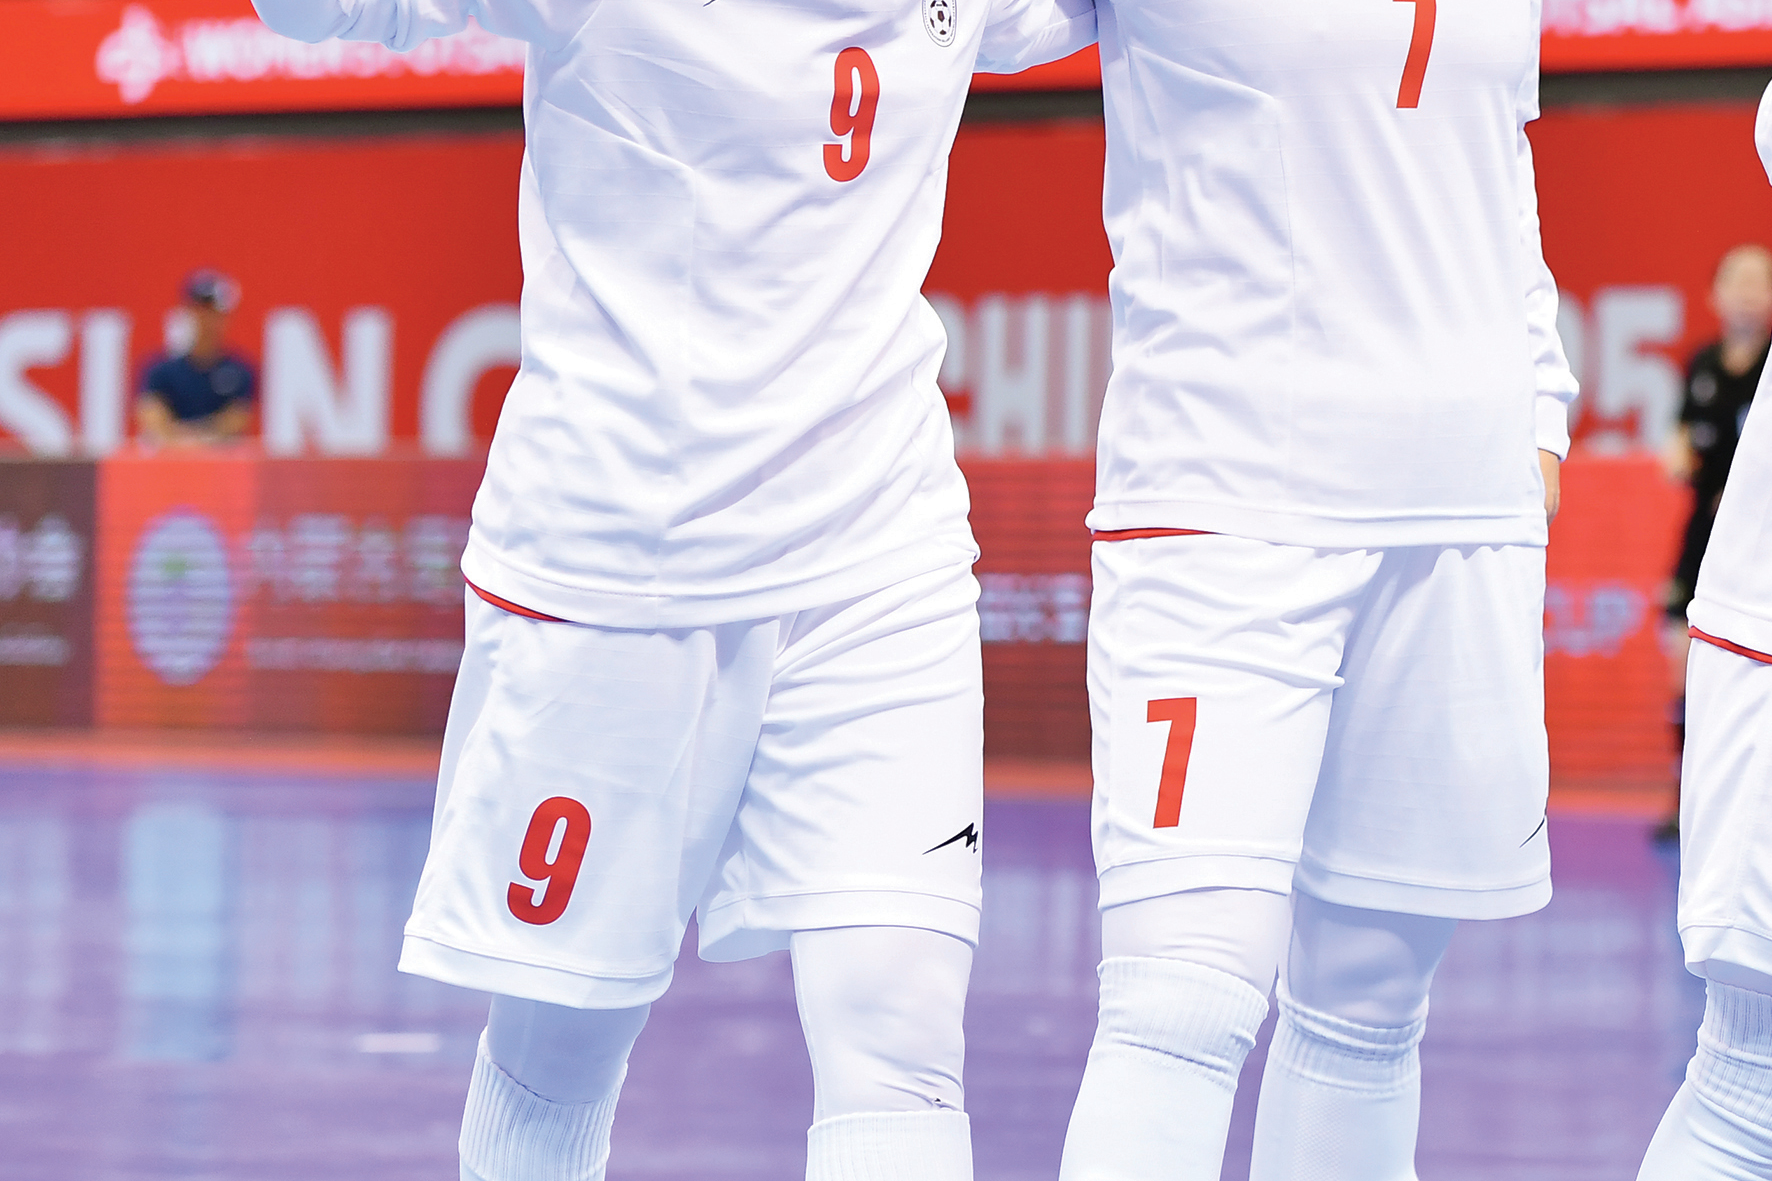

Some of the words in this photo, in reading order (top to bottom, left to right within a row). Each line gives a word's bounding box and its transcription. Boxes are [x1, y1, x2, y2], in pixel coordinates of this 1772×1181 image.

[823, 47, 880, 182] 9
[1146, 697, 1197, 829] 7
[508, 796, 591, 925] 9
